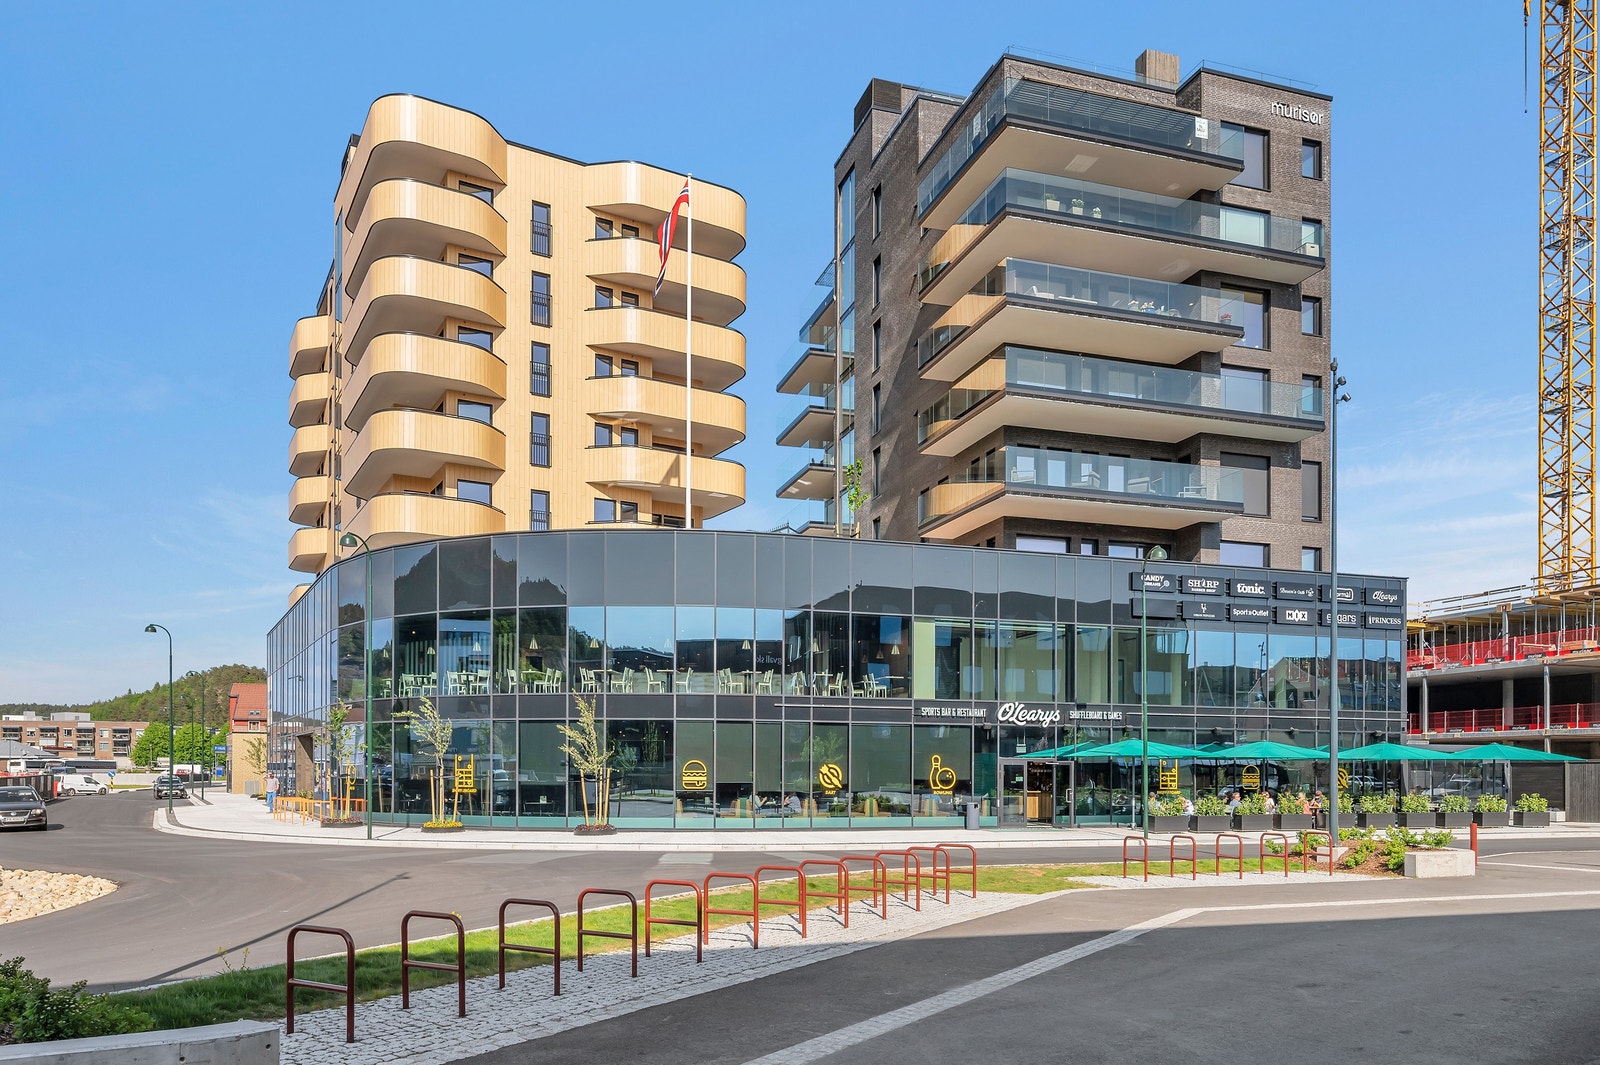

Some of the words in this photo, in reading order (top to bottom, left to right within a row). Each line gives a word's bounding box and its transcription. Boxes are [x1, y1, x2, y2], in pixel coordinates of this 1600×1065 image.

[1271, 102, 1323, 124] murisør
[1141, 574, 1164, 582] CANDY
[1286, 611, 1307, 620] MIX
[1327, 614, 1356, 624] egars
[1371, 616, 1401, 625] PRINCESS
[921, 707, 940, 716] SPORTS
[941, 707, 951, 716] BAR
[952, 708, 956, 716] &
[956, 708, 987, 717] RESTAURANT
[997, 701, 1060, 727] O'Learys
[1069, 710, 1102, 719] SHUFFLEBOARD
[1107, 711, 1122, 720] GAMES
